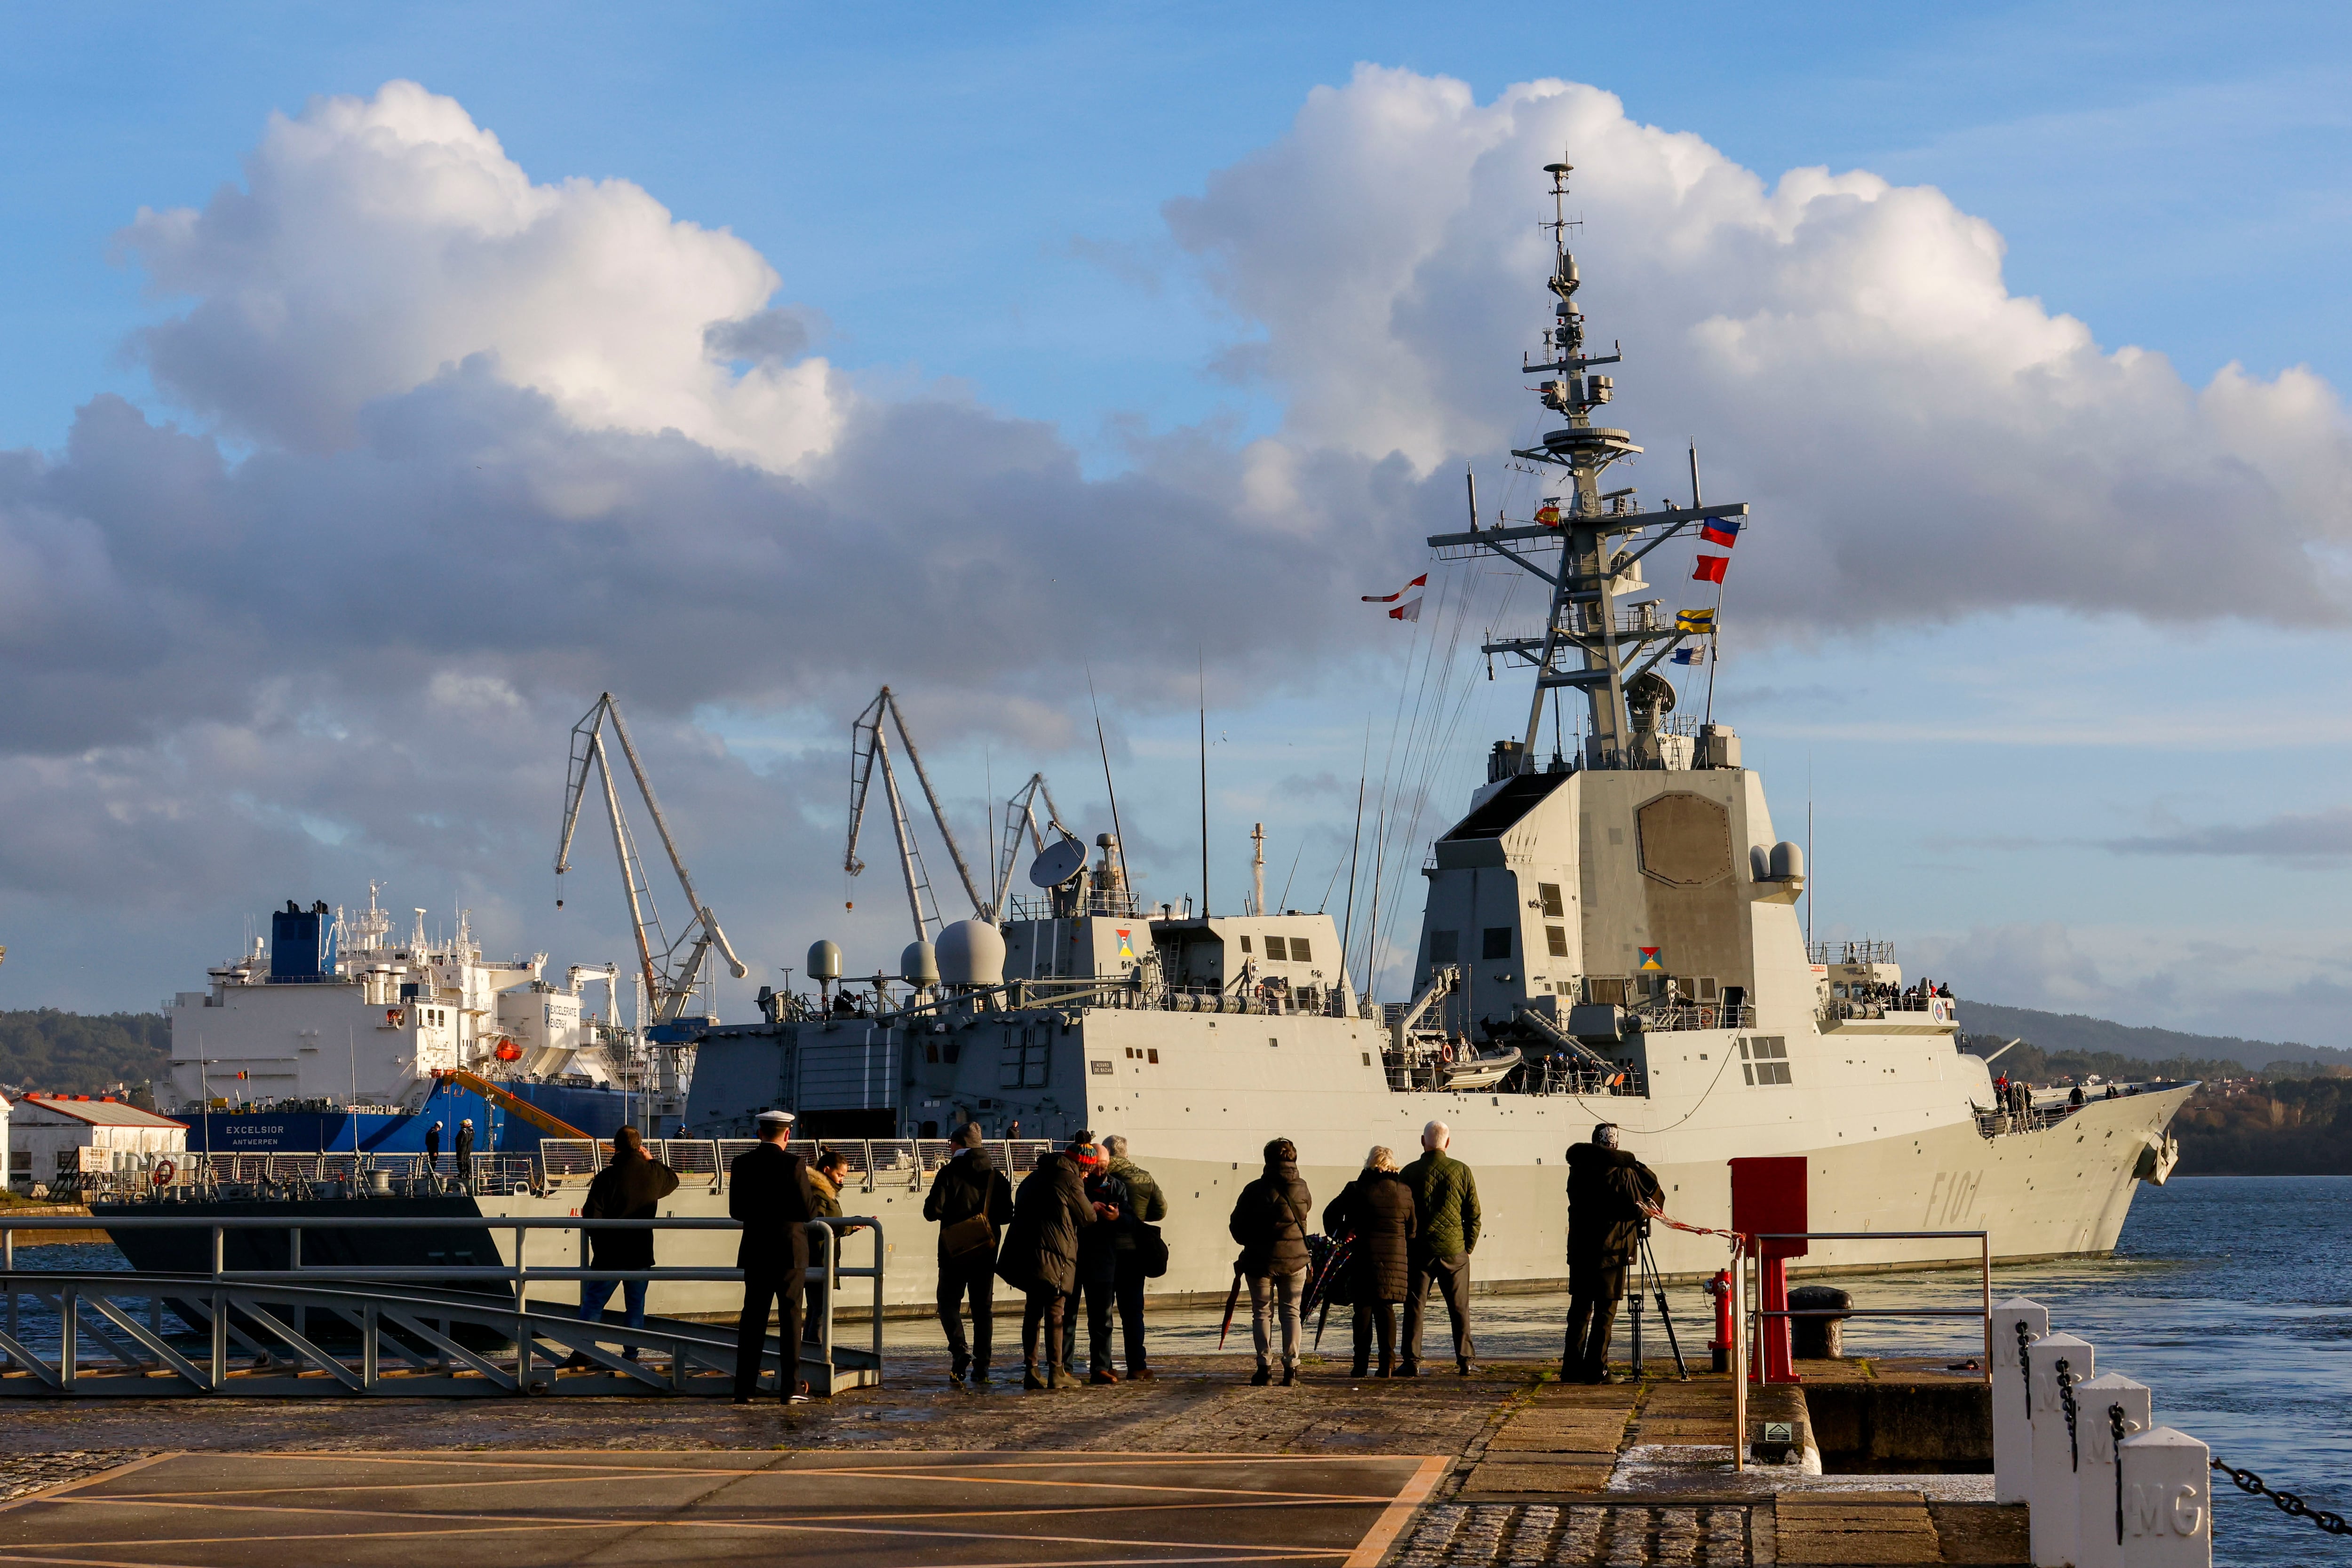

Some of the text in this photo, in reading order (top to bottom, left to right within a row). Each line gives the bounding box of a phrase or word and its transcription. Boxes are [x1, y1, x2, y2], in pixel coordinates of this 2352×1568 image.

[550, 1005, 577, 1017] EXCELERATE
[550, 1018, 567, 1029] ENERGY
[1923, 1169, 1984, 1227] F101
[888, 1244, 892, 1252] 9
[2085, 1419, 2141, 1464] M
[2132, 1484, 2201, 1537] MG
